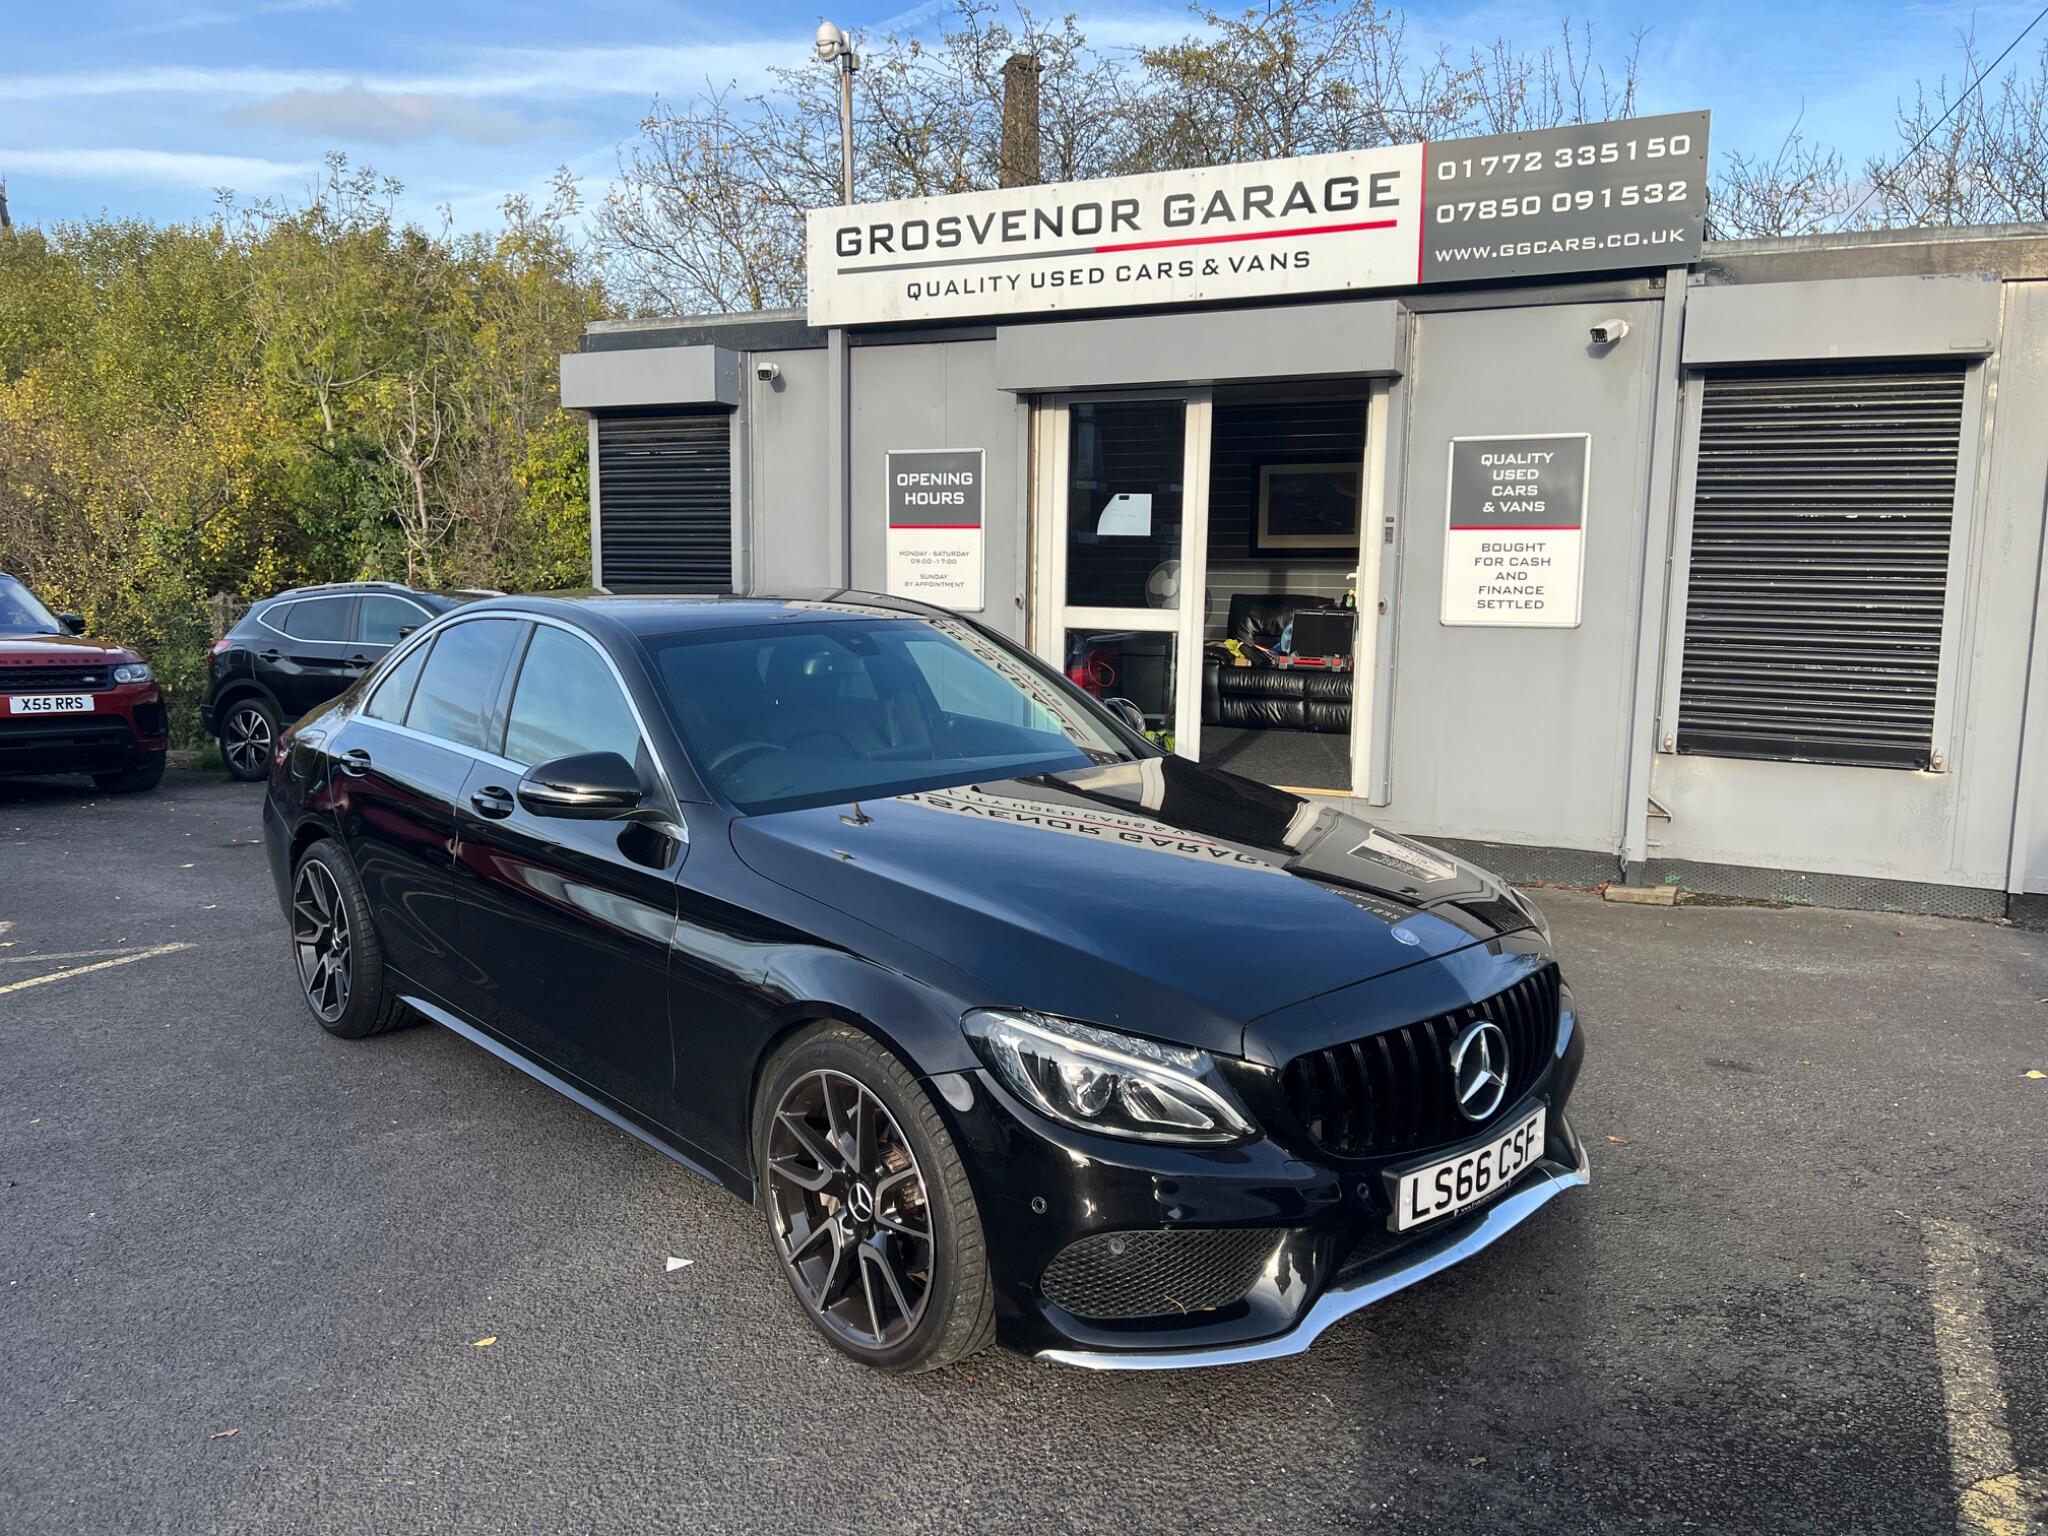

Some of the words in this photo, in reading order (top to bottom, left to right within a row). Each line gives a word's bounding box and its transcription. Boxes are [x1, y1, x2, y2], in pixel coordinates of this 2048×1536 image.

[1437, 151, 1543, 181] 01772
[1554, 134, 1691, 169] 335150
[1436, 195, 1541, 224] 07850
[1551, 181, 1688, 212] 091532
[835, 198, 1142, 257] GROSVENOR
[1163, 170, 1401, 228] GARAGE
[1435, 228, 1685, 263] WWW.GGCARS.CO.UK
[907, 274, 1021, 301] QUALITY
[1030, 267, 1105, 289] USED
[1115, 259, 1194, 282] CARS
[1202, 258, 1220, 276] &
[1228, 250, 1311, 274] VANS
[1481, 452, 1554, 467] QUALITY
[896, 472, 973, 486] OPENING
[1492, 469, 1540, 481] USED
[904, 491, 965, 505] HOURS
[1491, 485, 1538, 497] CARS
[1482, 501, 1495, 513] &
[1499, 500, 1546, 512] VANS
[1481, 542, 1546, 553] BOUGHT
[1474, 557, 1504, 567] FOR
[1509, 557, 1551, 567] CASH
[1495, 571, 1528, 581] AND
[1478, 585, 1545, 595] FINANCE
[1477, 599, 1544, 610] SETTLED
[22, 697, 52, 711] X55
[55, 696, 84, 710] RRS
[1411, 1150, 1492, 1221] LS66
[1497, 1117, 1538, 1180] CSF
